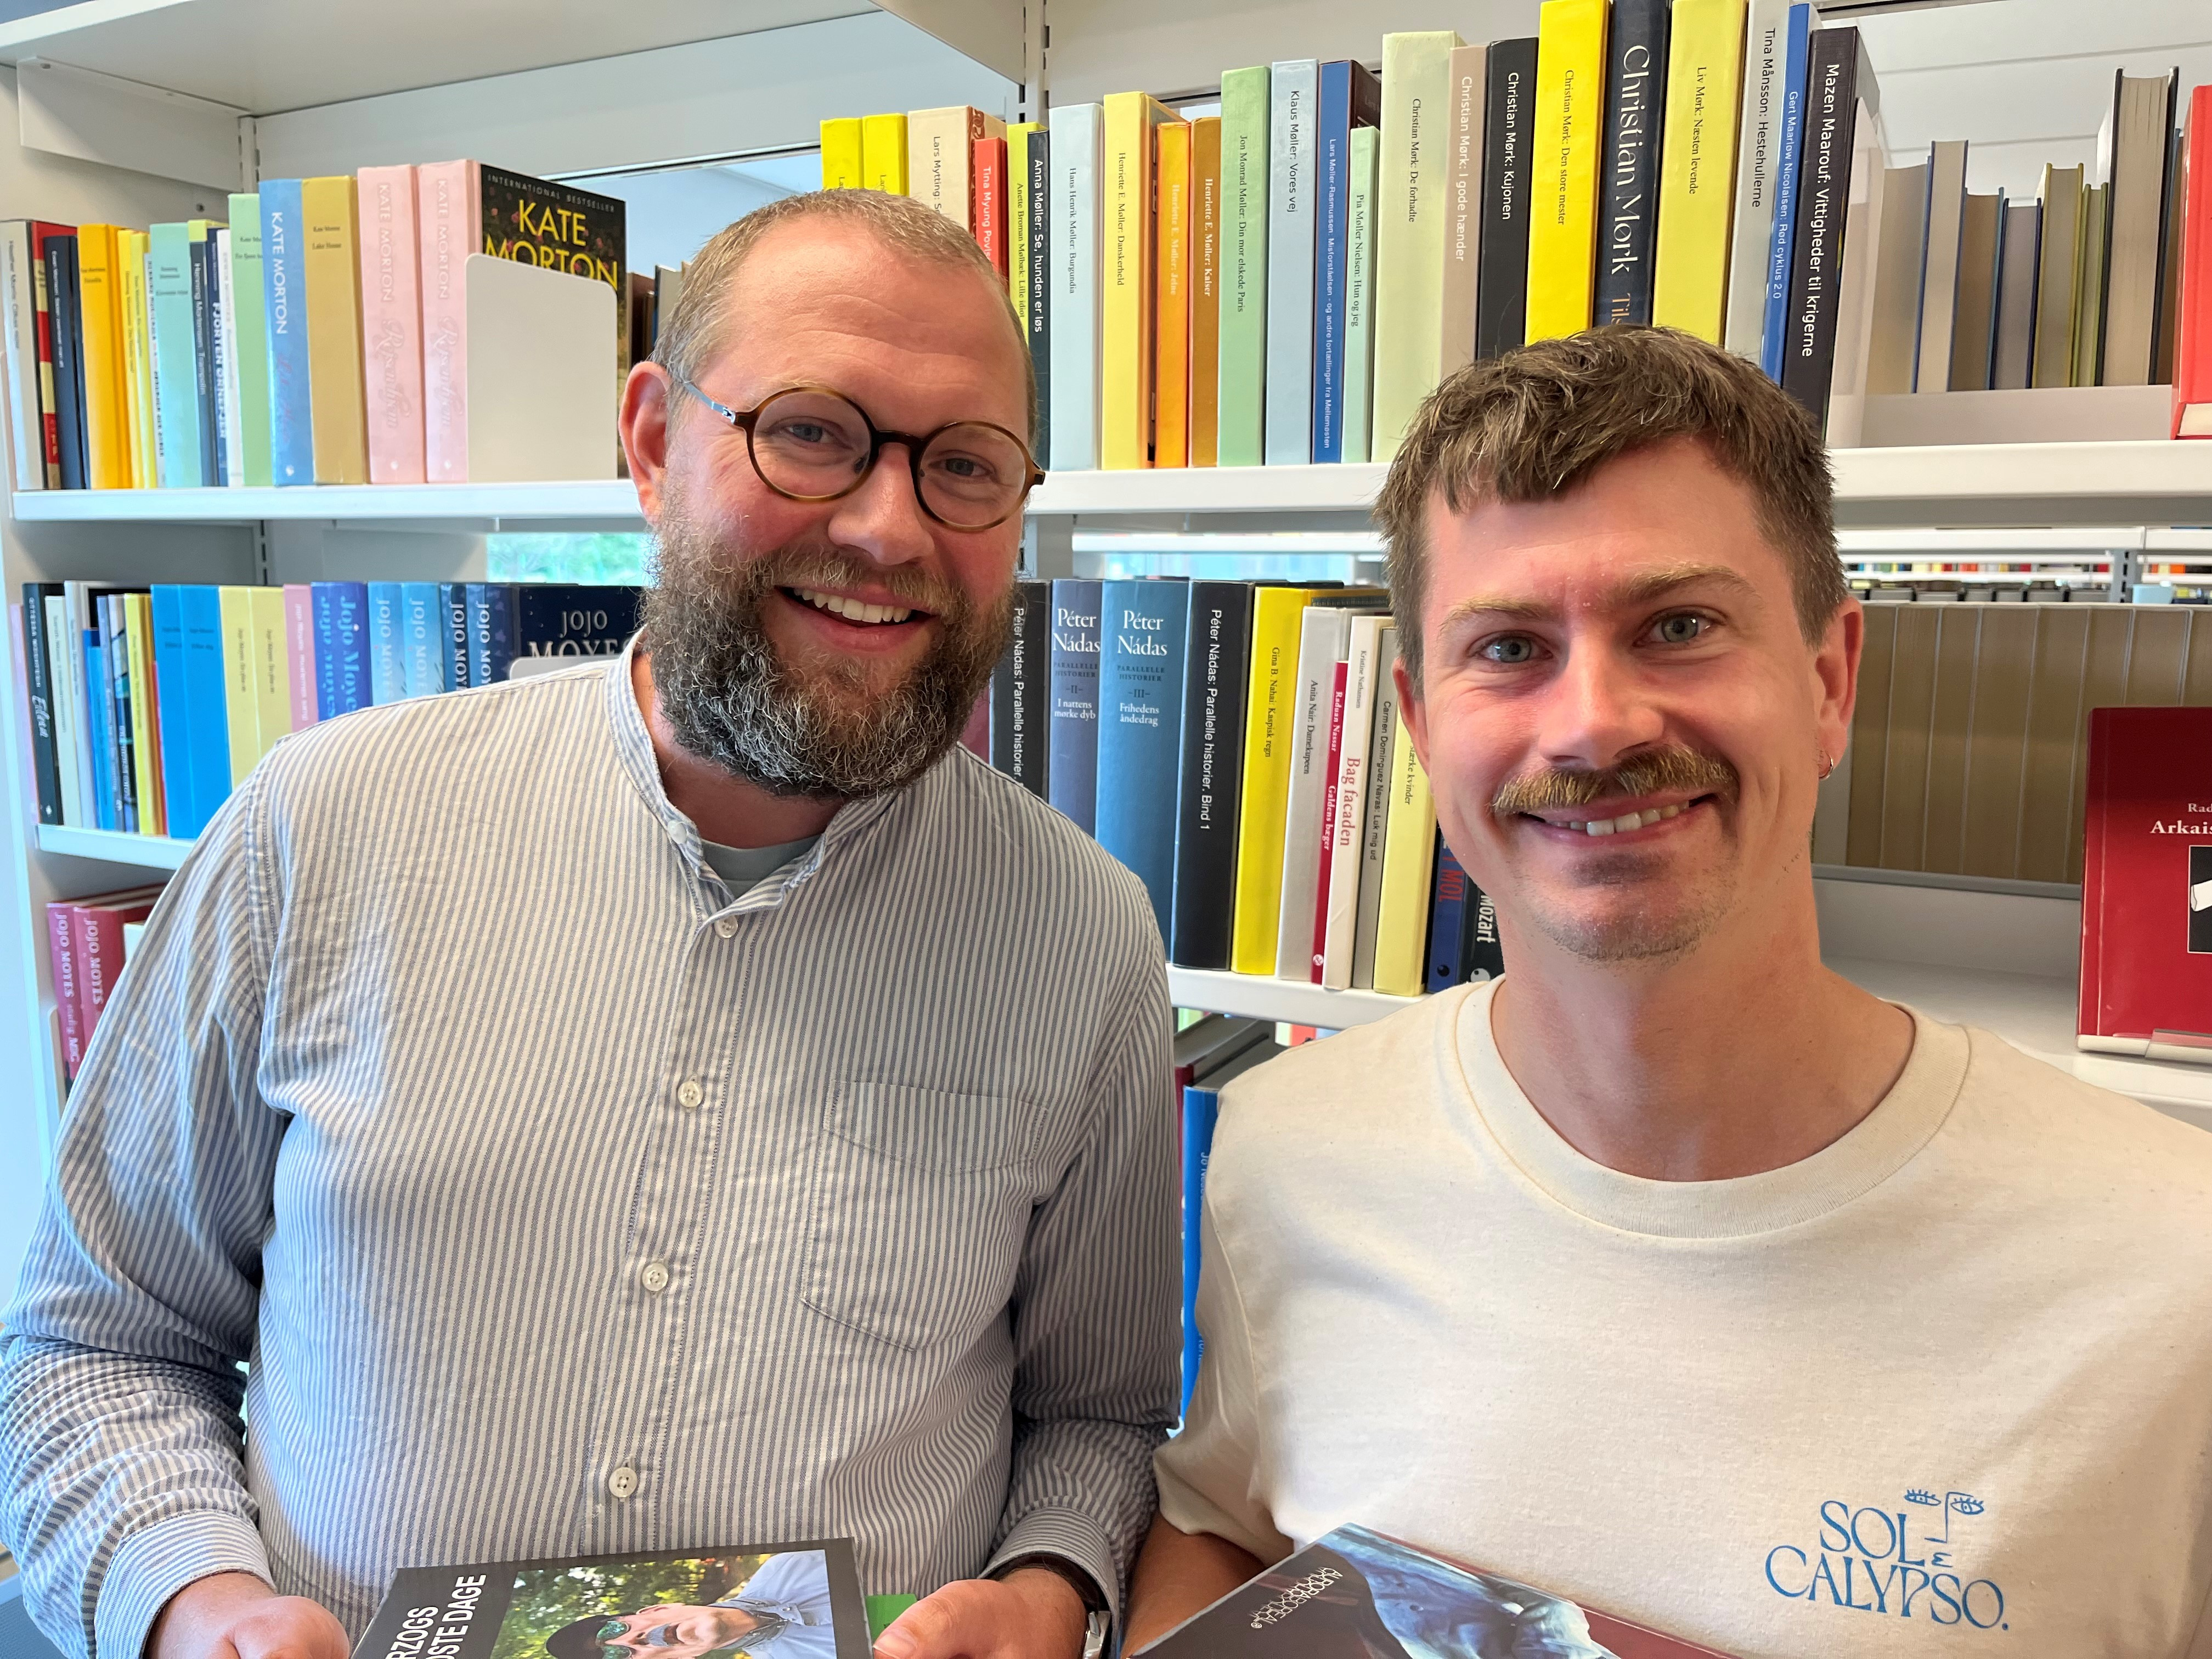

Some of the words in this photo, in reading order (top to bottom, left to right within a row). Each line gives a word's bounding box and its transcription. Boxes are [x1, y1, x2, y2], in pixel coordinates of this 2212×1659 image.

[1764, 27, 1775, 54] Tina
[1697, 66, 1706, 82] Liv
[1759, 59, 1774, 116] Månsson:
[1823, 64, 1839, 113] Mazen
[1291, 91, 1299, 120] Klaus
[1460, 77, 1472, 131] Christian
[1506, 72, 1519, 128] Christian
[1564, 70, 1574, 112] Christian
[1695, 87, 1705, 116] Mørk:
[1412, 99, 1420, 138] Christian
[1561, 116, 1572, 144] Mørk:
[1616, 45, 1650, 187] Christian
[1290, 124, 1299, 159] Møller:
[1459, 136, 1470, 169] Mørk:
[1504, 132, 1516, 166] Mørk:
[1692, 119, 1702, 155] Næsten
[1818, 119, 1835, 183] Maarouf:
[1239, 153, 1247, 185] Monrad
[1411, 142, 1420, 168] Mørk:
[1561, 148, 1570, 167] Den
[1752, 122, 1768, 207] Hestehullerne
[932, 160, 941, 200] Mytting:
[983, 166, 991, 188] Tina
[1035, 160, 1043, 189] Anna
[1289, 163, 1298, 193] Vores
[1410, 171, 1418, 184] De
[1560, 170, 1568, 192] store
[1689, 158, 1701, 194] levende
[379, 184, 392, 219] KATE
[438, 180, 448, 217] KATE
[488, 174, 560, 199] INTERNATIONAL
[566, 194, 614, 212] BESTSELLER
[1205, 179, 1213, 219] Henriette
[1287, 197, 1298, 212] vej
[1409, 187, 1418, 222] forhadte
[1456, 181, 1467, 210] gode
[1501, 171, 1514, 219] Kujonen
[519, 199, 586, 246] KATE
[981, 192, 991, 227] Myung
[1035, 193, 1044, 230] Møller:
[1558, 195, 1567, 225] mester
[272, 212, 284, 254] KATE
[1205, 222, 1212, 230] E.
[1456, 215, 1467, 261] hænder
[1611, 194, 1641, 275] Mørk
[1810, 188, 1830, 272] Vittigheder
[1034, 235, 1043, 251] Se,
[1204, 234, 1212, 265] Møller:
[380, 228, 394, 301] MORTON
[438, 227, 449, 298] MORTON
[486, 234, 618, 291] MORTON
[1068, 253, 1076, 294] Burgundia
[1355, 242, 1363, 277] Nielsen:
[1035, 256, 1044, 298] hunden
[1204, 268, 1212, 296] Kaiser
[1808, 276, 1821, 290] til
[273, 258, 287, 334] MORTON
[1035, 302, 1042, 313] er
[1352, 301, 1359, 311] og
[1035, 317, 1043, 332] løs
[1351, 313, 1359, 327] jeg
[1802, 296, 1820, 357] krigerne
[449, 601, 465, 642] JOJO
[559, 610, 607, 639] JOJO
[1014, 608, 1024, 637] Péter
[1058, 608, 1097, 628] Péter
[1123, 610, 1164, 630] Péter
[1210, 610, 1222, 641] Péter
[1053, 633, 1101, 652] Nádas
[1118, 635, 1167, 656] Nádas
[1271, 647, 1280, 666] Gina
[1014, 640, 1024, 678] Nádas:
[1207, 645, 1220, 685] Nádas:
[1271, 669, 1278, 677] B.
[1014, 682, 1024, 731] Parallelle
[1058, 698, 1061, 707] I
[1269, 679, 1277, 704] Nahai:
[1310, 680, 1318, 701] Anita
[1333, 691, 1343, 722] Raduan
[1356, 676, 1365, 708] Nathansen
[1054, 709, 1079, 718] mørke
[1080, 710, 1096, 721] dyb
[1120, 703, 1159, 714] Frihedens
[1120, 714, 1158, 727] åndedrag
[1205, 688, 1218, 740] Parallelle
[1266, 708, 1276, 738] Kaspisk
[1308, 703, 1317, 723] Nair:
[1382, 701, 1391, 733] Carmen
[1303, 725, 1315, 774] Damekupeen
[1331, 725, 1340, 752] Nassar
[1014, 733, 1024, 780] historier.
[1202, 743, 1215, 792] historier.
[1341, 757, 1361, 785] Bag
[1326, 786, 1336, 821] Galdens
[1374, 785, 1384, 812] Navas:
[1405, 775, 1414, 805] kvinder
[1200, 795, 1212, 821] Bind
[1340, 789, 1358, 846] facaden
[1373, 815, 1381, 830] Luk
[2188, 803, 2212, 812] Rad
[1323, 824, 1334, 850] bæger
[1369, 832, 1379, 847] mig
[1370, 850, 1376, 860] ud
[1438, 868, 1464, 902] MOL
[55, 912, 70, 947] JOJO
[1476, 895, 1496, 943] Mozart
[83, 918, 100, 953] JOJO
[60, 951, 74, 997] MOYES
[89, 957, 104, 1005] MOYES
[1820, 1500, 1925, 1566] SOL
[442, 1575, 486, 1622] DAGE
[1765, 1545, 2008, 1631] CALYPSO.
